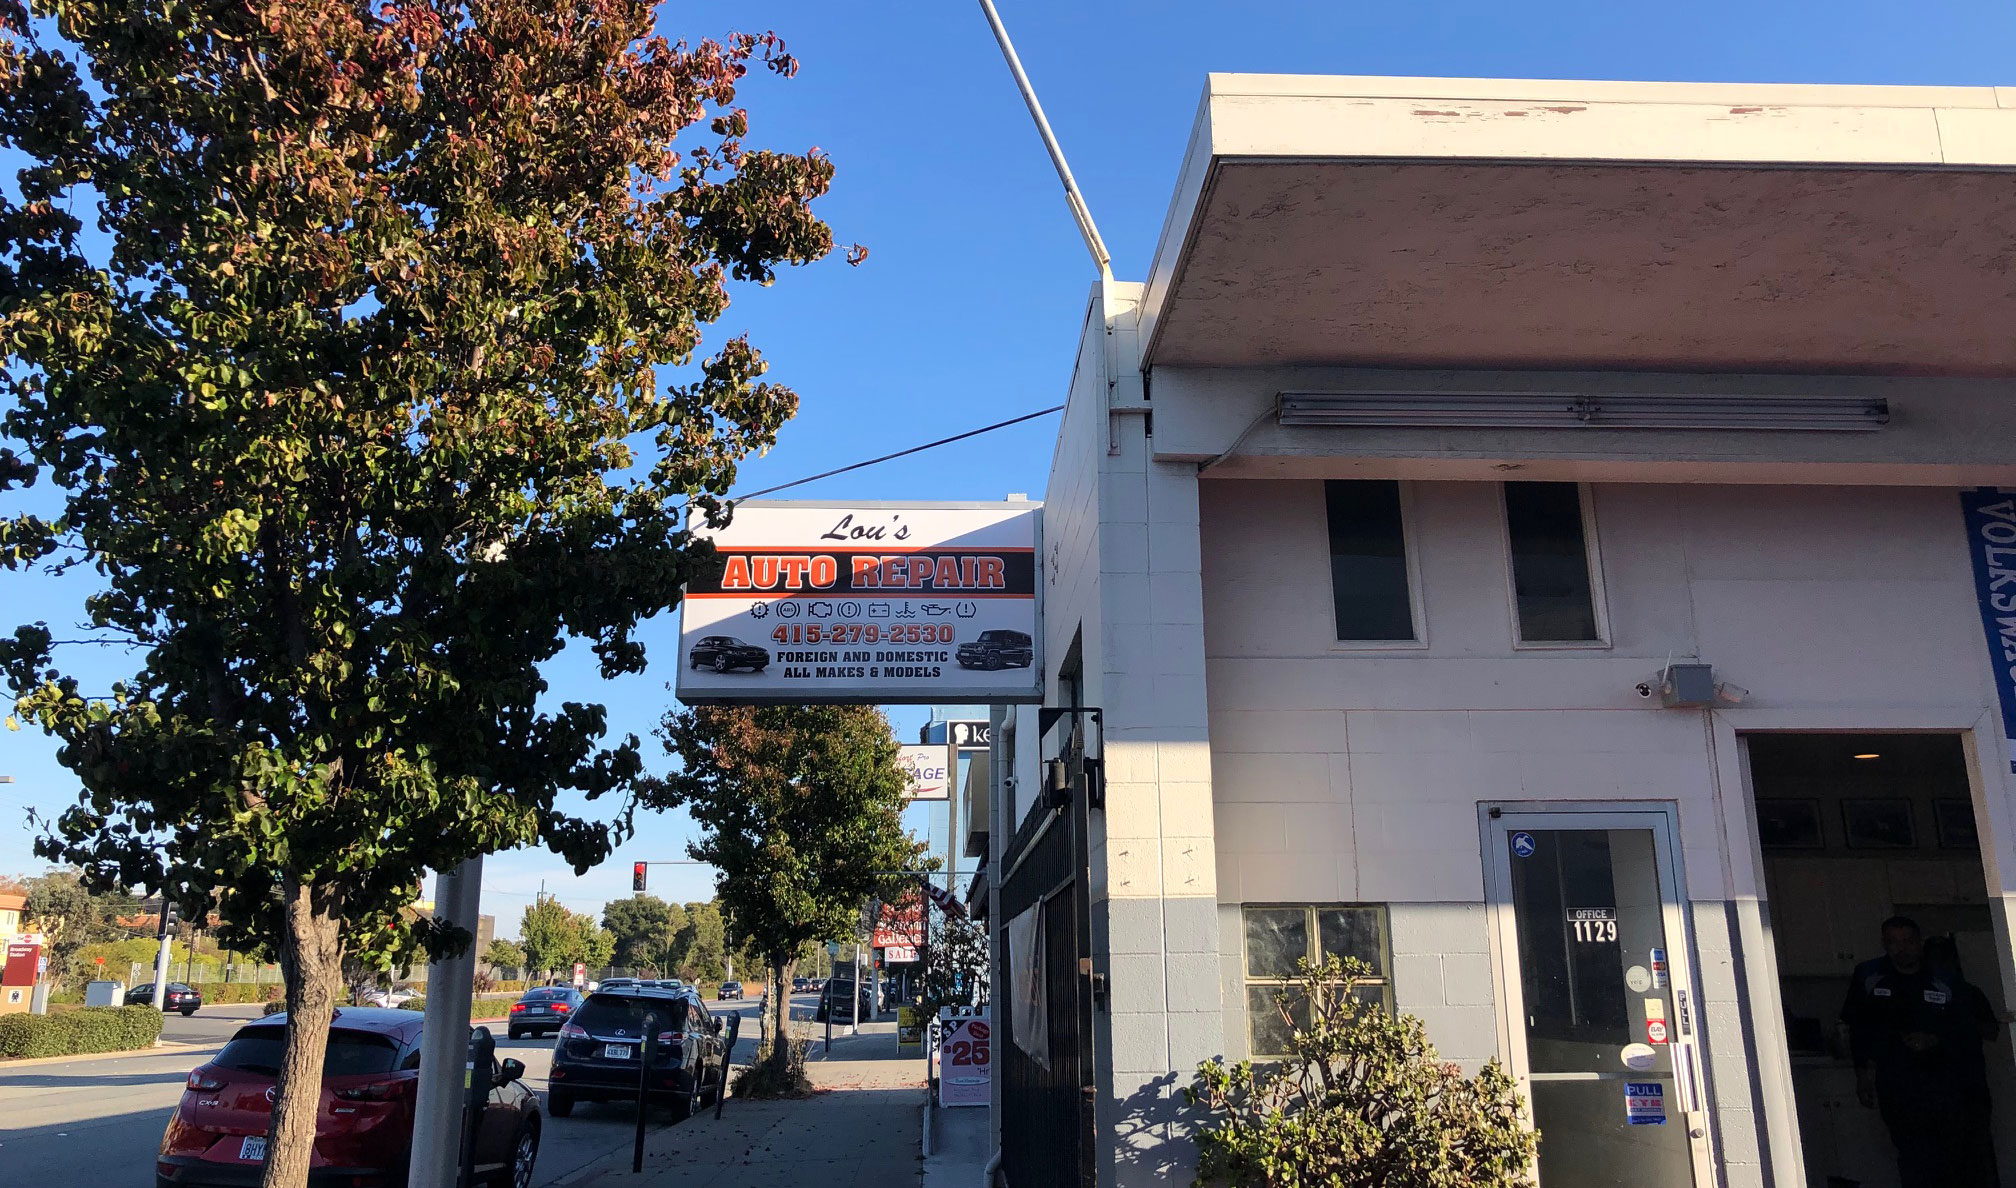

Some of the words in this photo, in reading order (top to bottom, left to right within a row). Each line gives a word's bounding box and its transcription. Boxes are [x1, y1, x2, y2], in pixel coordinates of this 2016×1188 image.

[820, 513, 911, 541] Lou's
[721, 554, 838, 590] AUTO
[850, 554, 1006, 590] REPAIR
[1977, 499, 2016, 700] VOLKSW
[771, 623, 955, 645] 415-279-2530
[777, 651, 838, 663] FOREIGN
[842, 651, 871, 663] AND
[875, 651, 948, 663] DOMESTIC
[783, 667, 811, 678] ALL
[816, 667, 866, 678] MAKES
[869, 667, 879, 678] &
[884, 666, 941, 678] MODELS
[1575, 909, 1607, 919] OFFICE
[1574, 921, 1617, 942] 1129
[577, 964, 583, 973] P
[1680, 993, 1689, 1025] PULL
[1627, 1086, 1660, 1096] PULL
